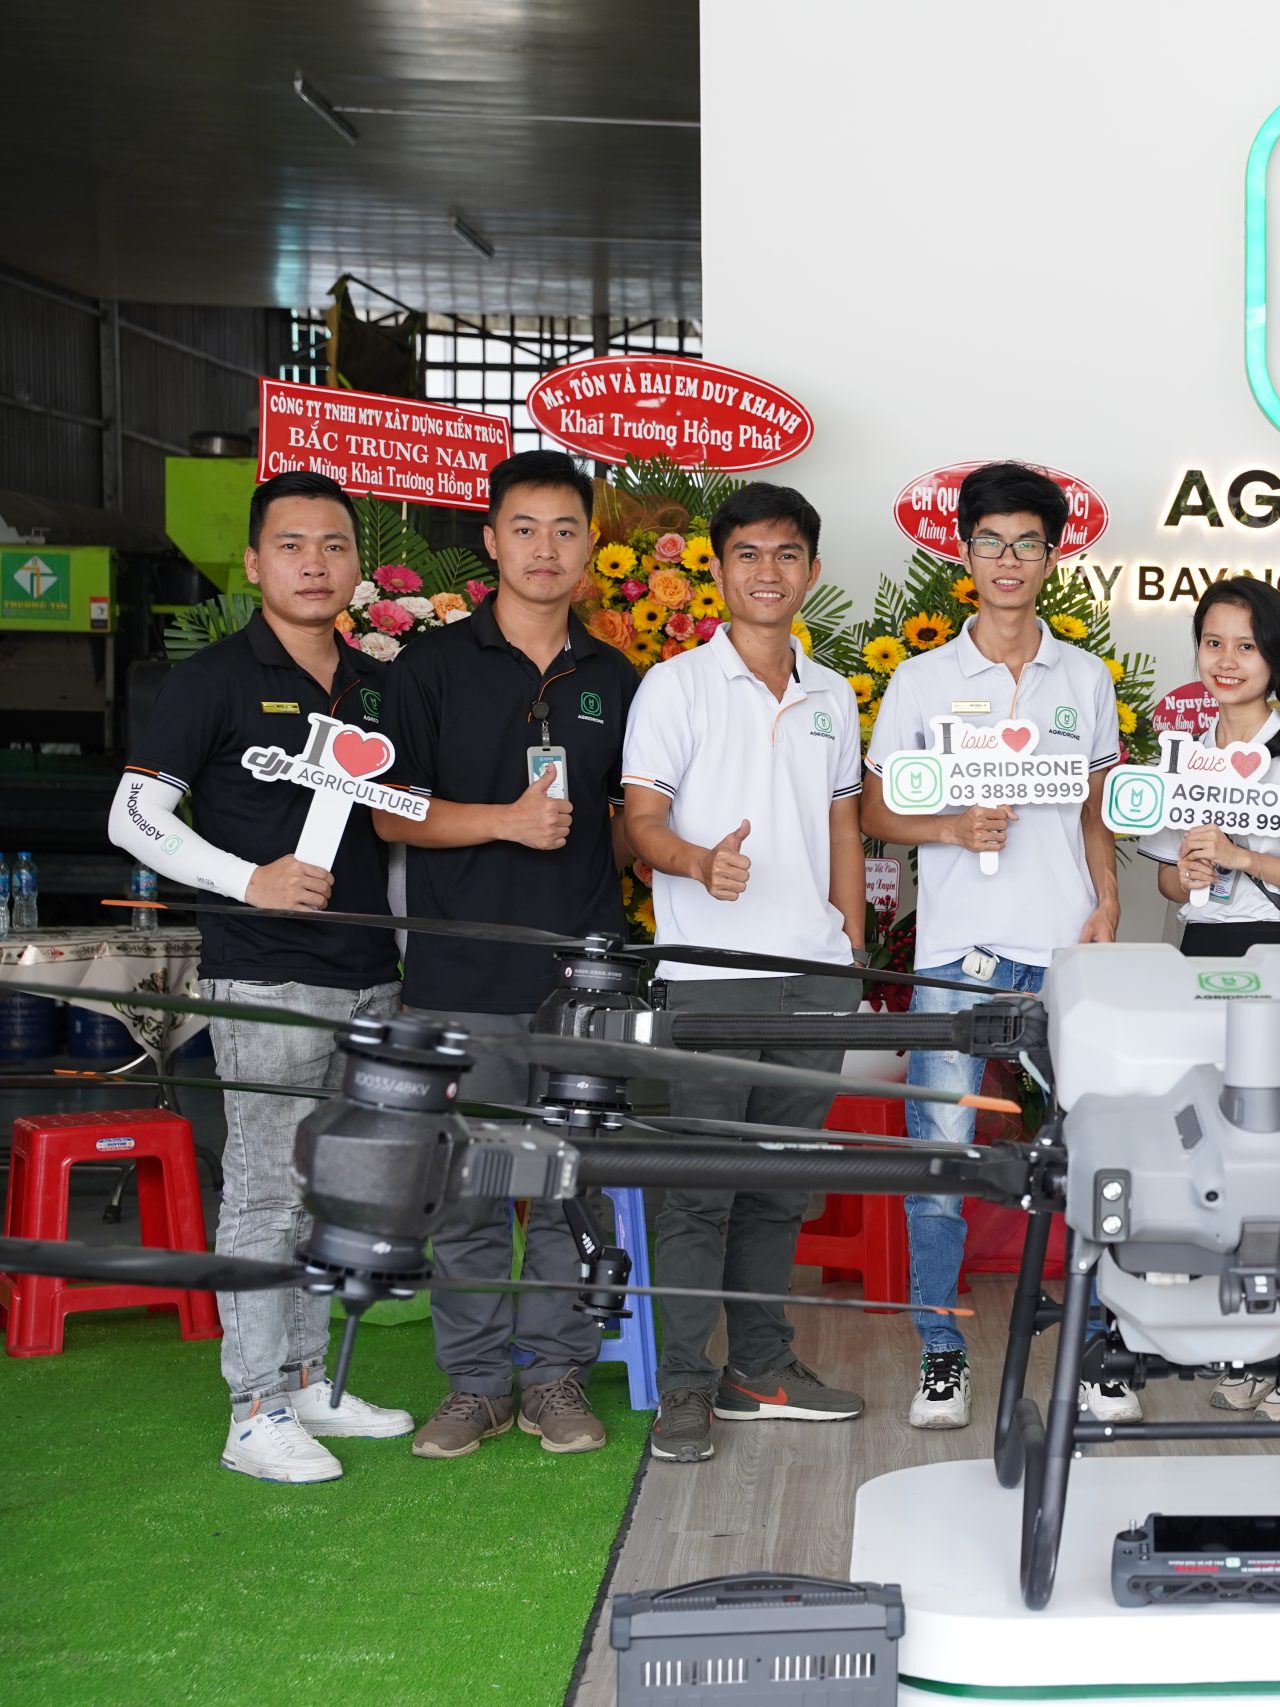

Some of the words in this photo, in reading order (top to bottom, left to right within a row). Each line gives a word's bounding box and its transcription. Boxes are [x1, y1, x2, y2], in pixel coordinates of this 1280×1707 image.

[270, 391, 303, 416] CÔNG
[306, 400, 321, 418] TY
[324, 403, 356, 424] TNHH
[358, 409, 383, 426] MTV
[385, 408, 410, 430] XÂY
[412, 413, 443, 437] DỰNG
[445, 416, 473, 441] KIẾN
[538, 387, 571, 411] Mr.
[570, 371, 608, 400] TÔN
[610, 367, 636, 394] VÀ
[640, 372, 671, 395] HAI
[675, 375, 698, 399] EM
[702, 380, 739, 407] DUY
[739, 391, 802, 435] KHANH
[288, 420, 339, 451] BẮC
[346, 435, 430, 464] TRUNG
[436, 447, 488, 471] NAM
[559, 408, 604, 435] Khai
[610, 412, 677, 447] Trương
[683, 417, 733, 452] Hồng
[738, 425, 782, 451] Phát
[268, 451, 305, 473] Chúc
[309, 456, 347, 484] Mừng
[351, 461, 383, 486] Khai
[386, 466, 434, 495] Trương
[438, 472, 473, 500] Hồng
[911, 486, 932, 511] CH
[301, 718, 338, 769] I
[938, 722, 955, 755] I
[961, 730, 999, 750] love
[1048, 728, 1081, 741] AGRIDRONE
[1164, 739, 1184, 774] I
[1187, 750, 1227, 773] love
[950, 760, 1083, 778] AGRIDRONE
[950, 784, 975, 800] 03
[981, 783, 1028, 799] 3838
[1034, 782, 1084, 798] 9999
[126, 782, 166, 841] AGRIDRONE
[298, 768, 425, 816] AGRICULTURE
[1169, 808, 1195, 825] 03
[1201, 809, 1250, 829] 3838
